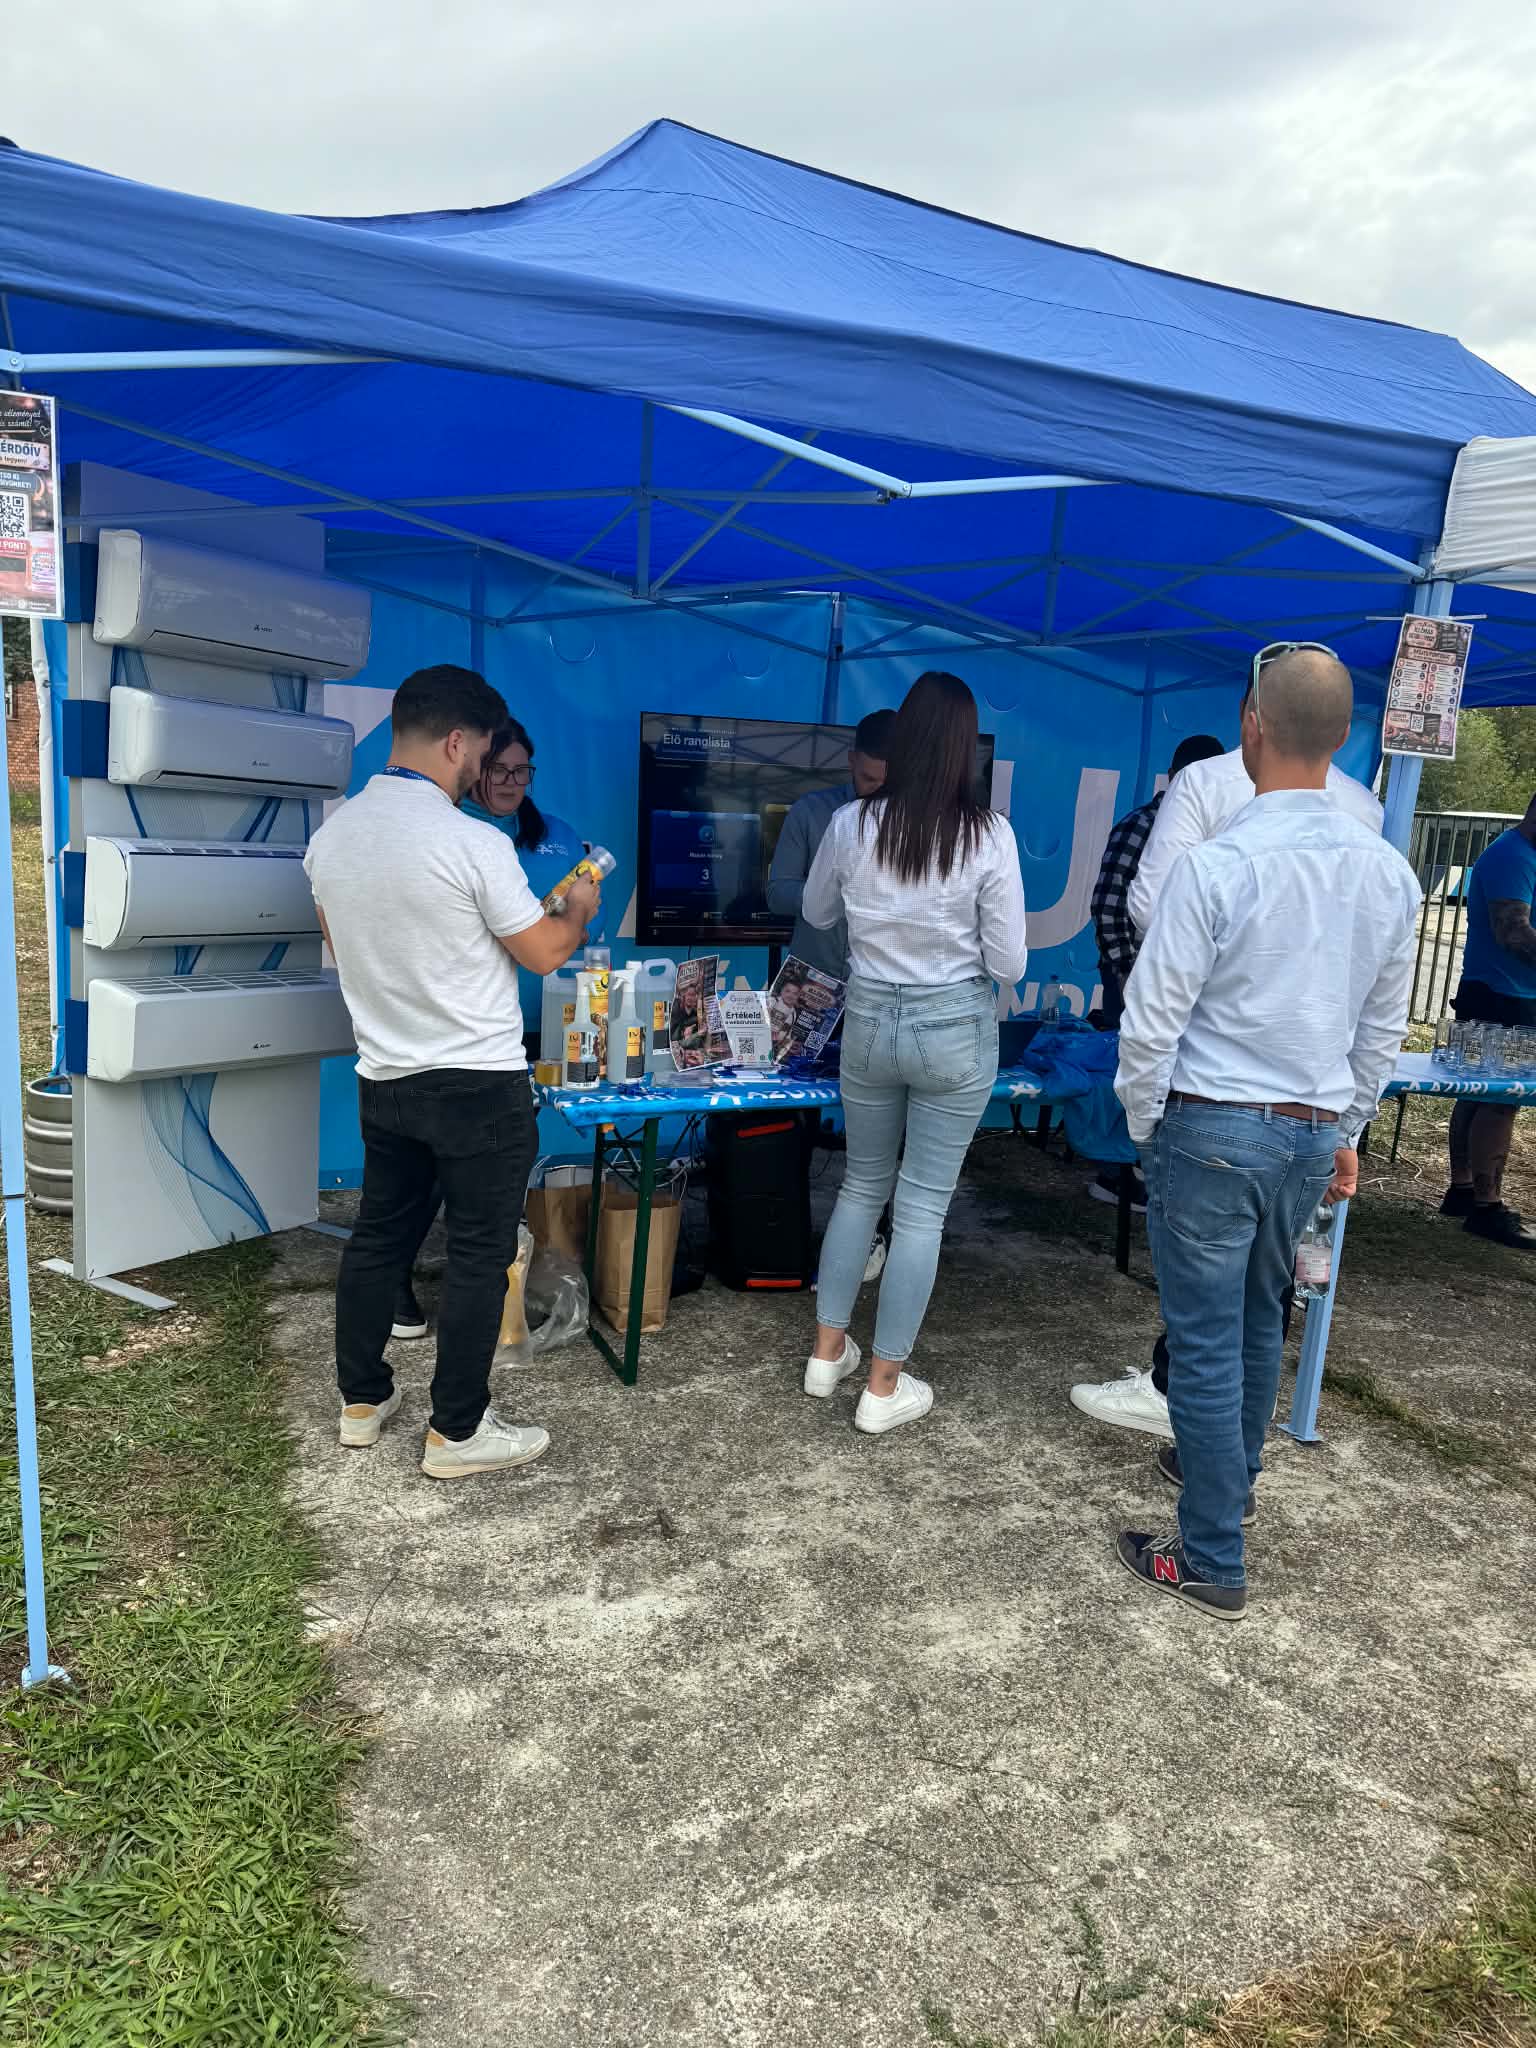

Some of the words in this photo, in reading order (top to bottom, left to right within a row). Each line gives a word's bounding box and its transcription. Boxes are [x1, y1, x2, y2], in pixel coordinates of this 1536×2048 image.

[683, 735, 731, 750] ranglista
[701, 868, 710, 881] 3
[1153, 1553, 1179, 1583] N
